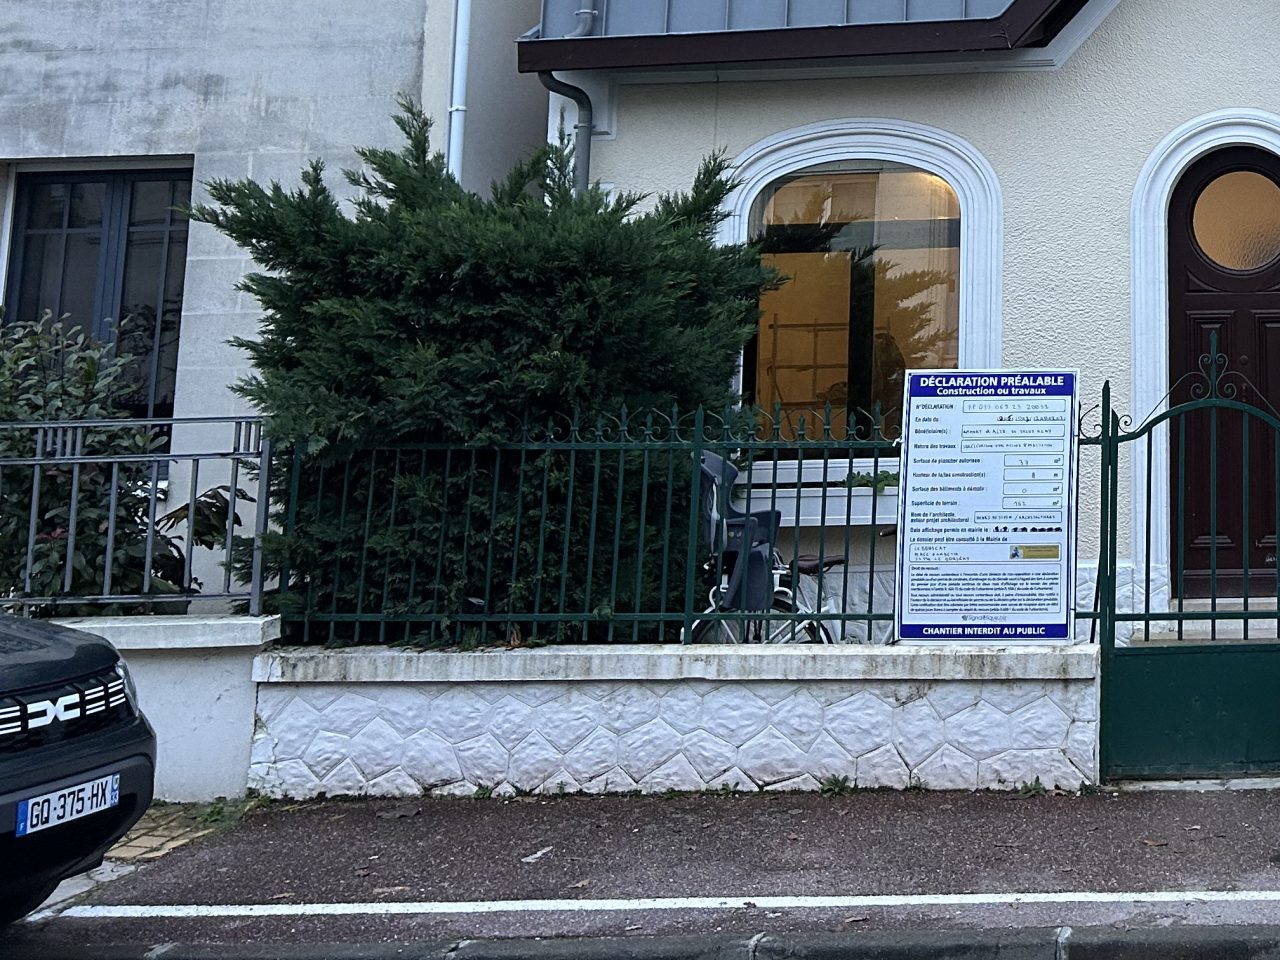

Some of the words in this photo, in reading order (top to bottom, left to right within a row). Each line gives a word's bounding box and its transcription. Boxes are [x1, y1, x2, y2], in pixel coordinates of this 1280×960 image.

[920, 375, 998, 387] DÉCLARATION
[1001, 375, 1064, 387] PRÉALABLE
[936, 387, 995, 396] Construction
[1011, 387, 1047, 395] travaux
[922, 627, 963, 636] CHANTIER
[964, 627, 1001, 635] INTERDIT
[1002, 627, 1015, 635] AU
[1017, 627, 1046, 635] PUBLIC
